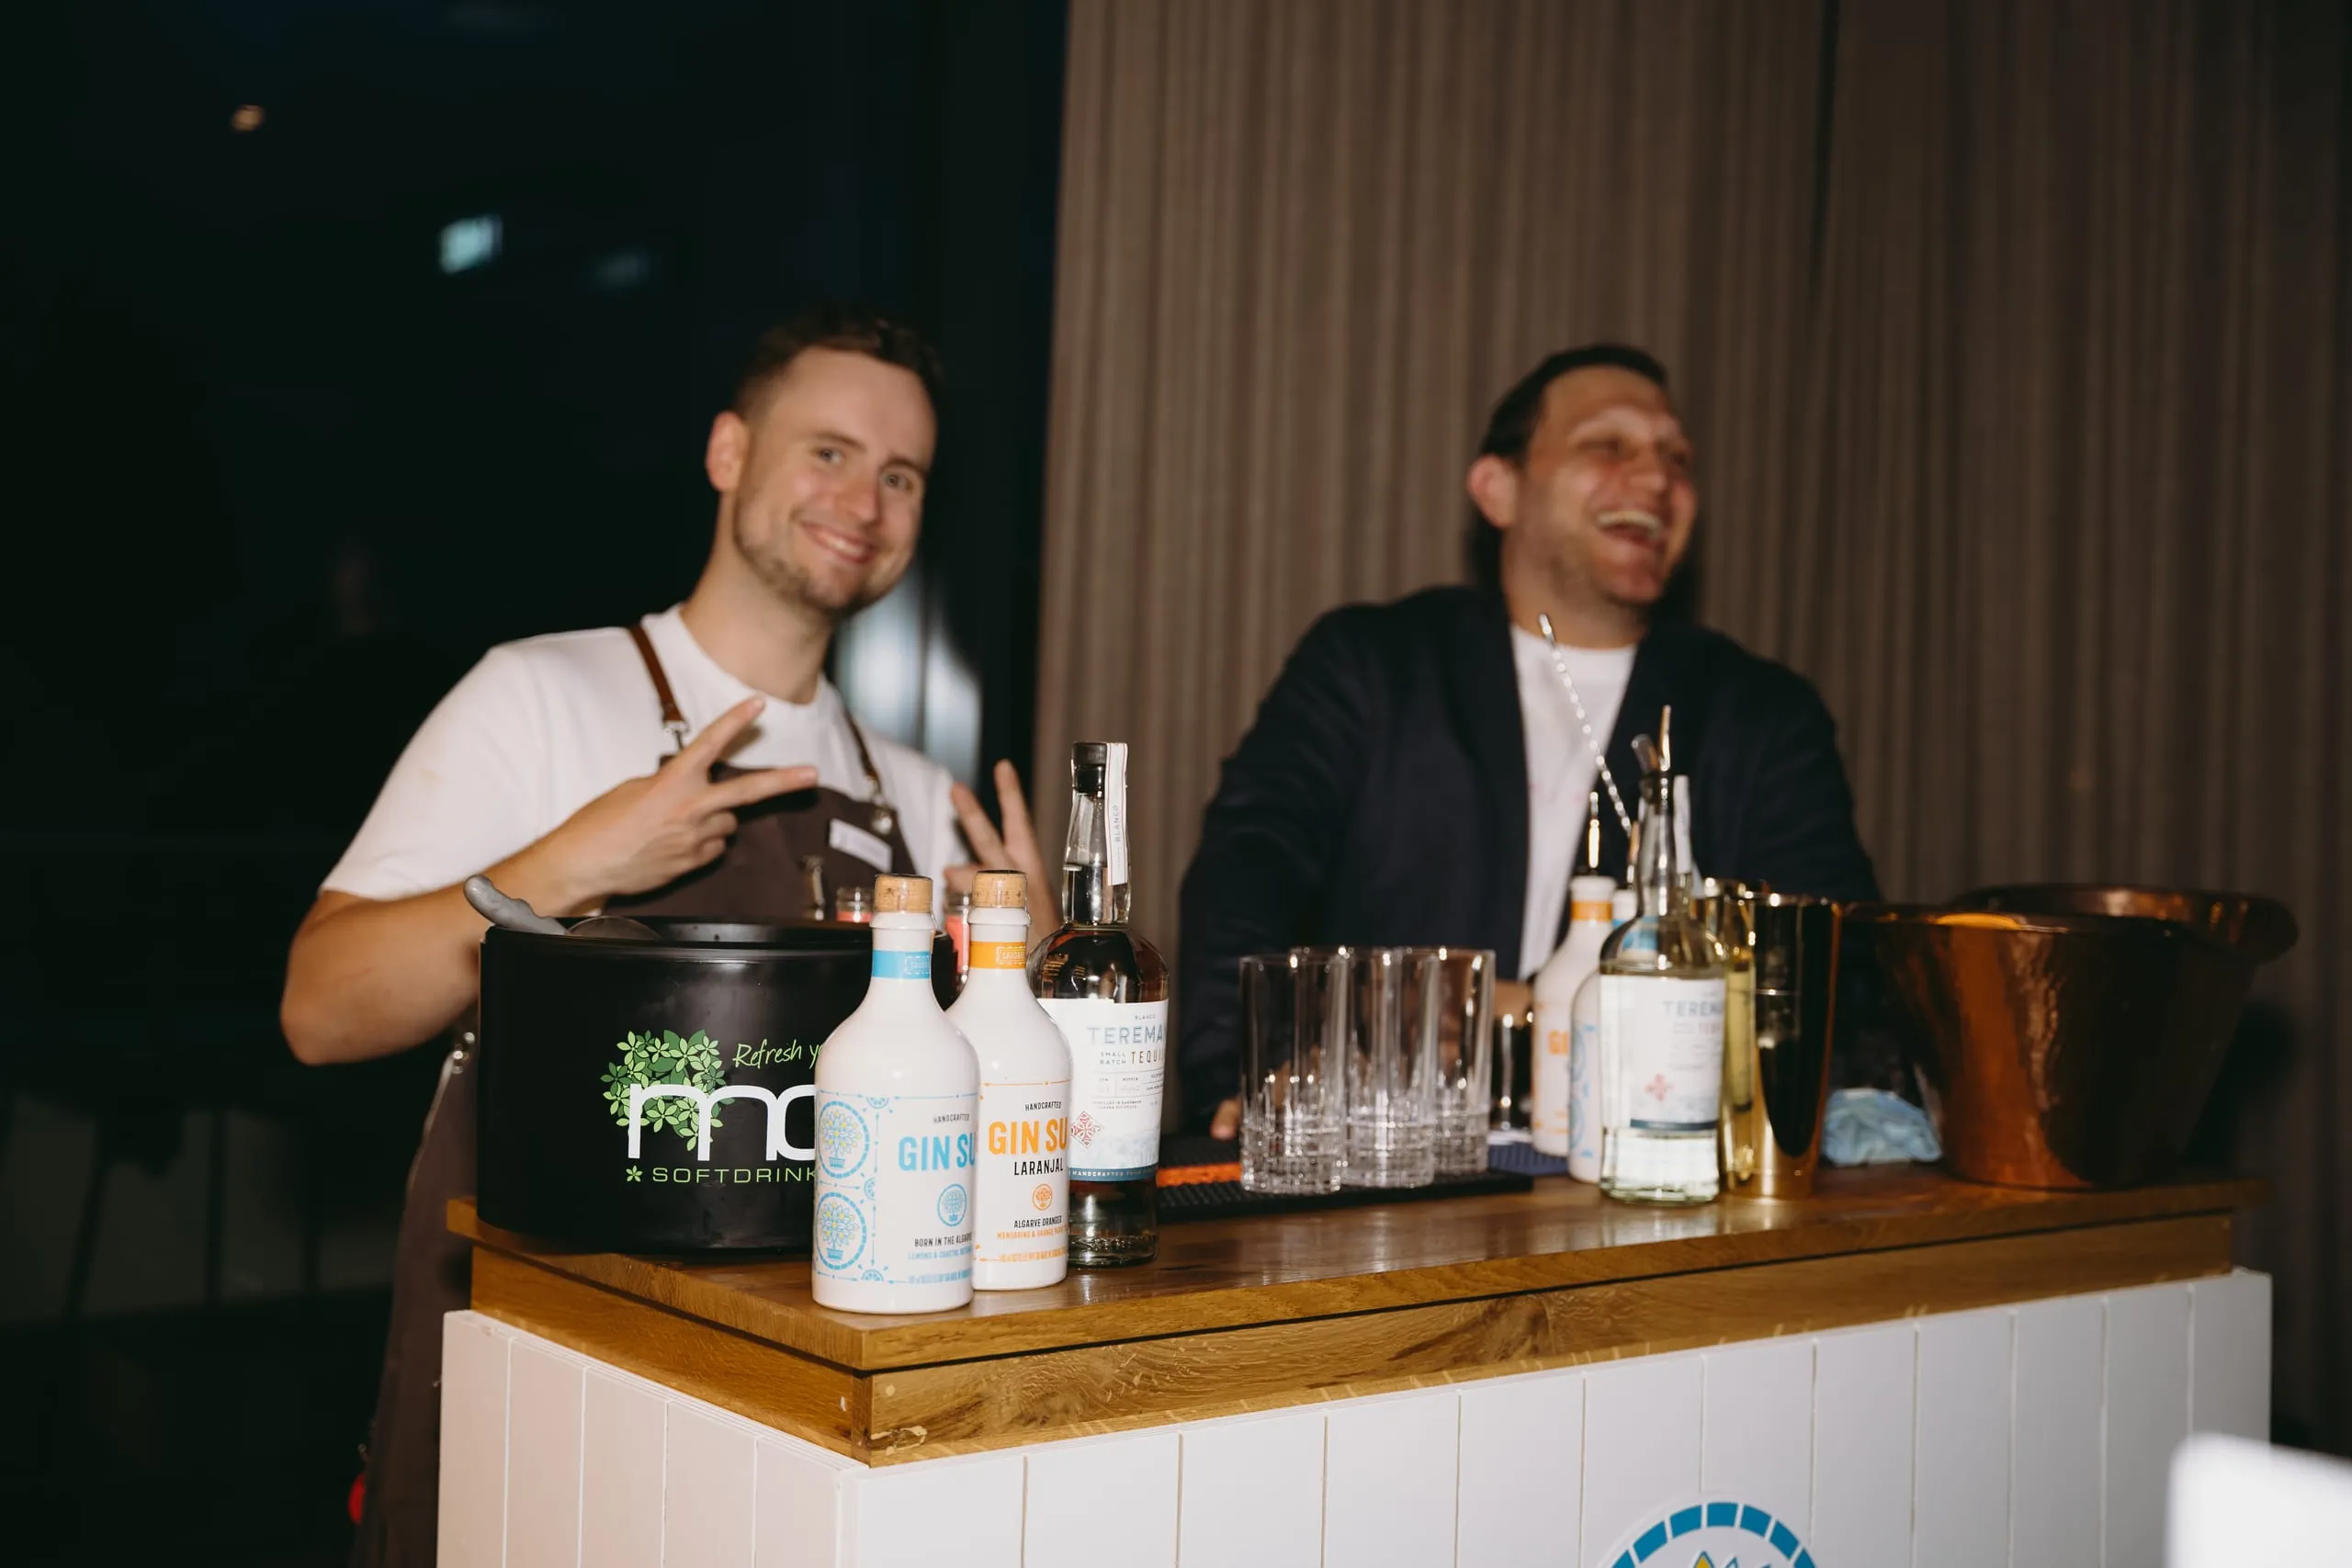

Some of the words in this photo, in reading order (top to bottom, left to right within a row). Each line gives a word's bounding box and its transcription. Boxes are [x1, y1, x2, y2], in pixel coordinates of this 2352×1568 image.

[732, 1039, 802, 1070] Refresh
[1024, 1100, 1062, 1111] HANDCRAFTED
[933, 1112, 970, 1123] HANDCRAFTED
[988, 1121, 1040, 1155] GIN
[898, 1134, 950, 1171] GIN
[1013, 1157, 1064, 1176] LARANJAL
[1013, 1218, 1041, 1229] ALGARVE
[914, 1237, 933, 1247] BORN
[934, 1236, 942, 1247] IN
[944, 1235, 955, 1246] THE
